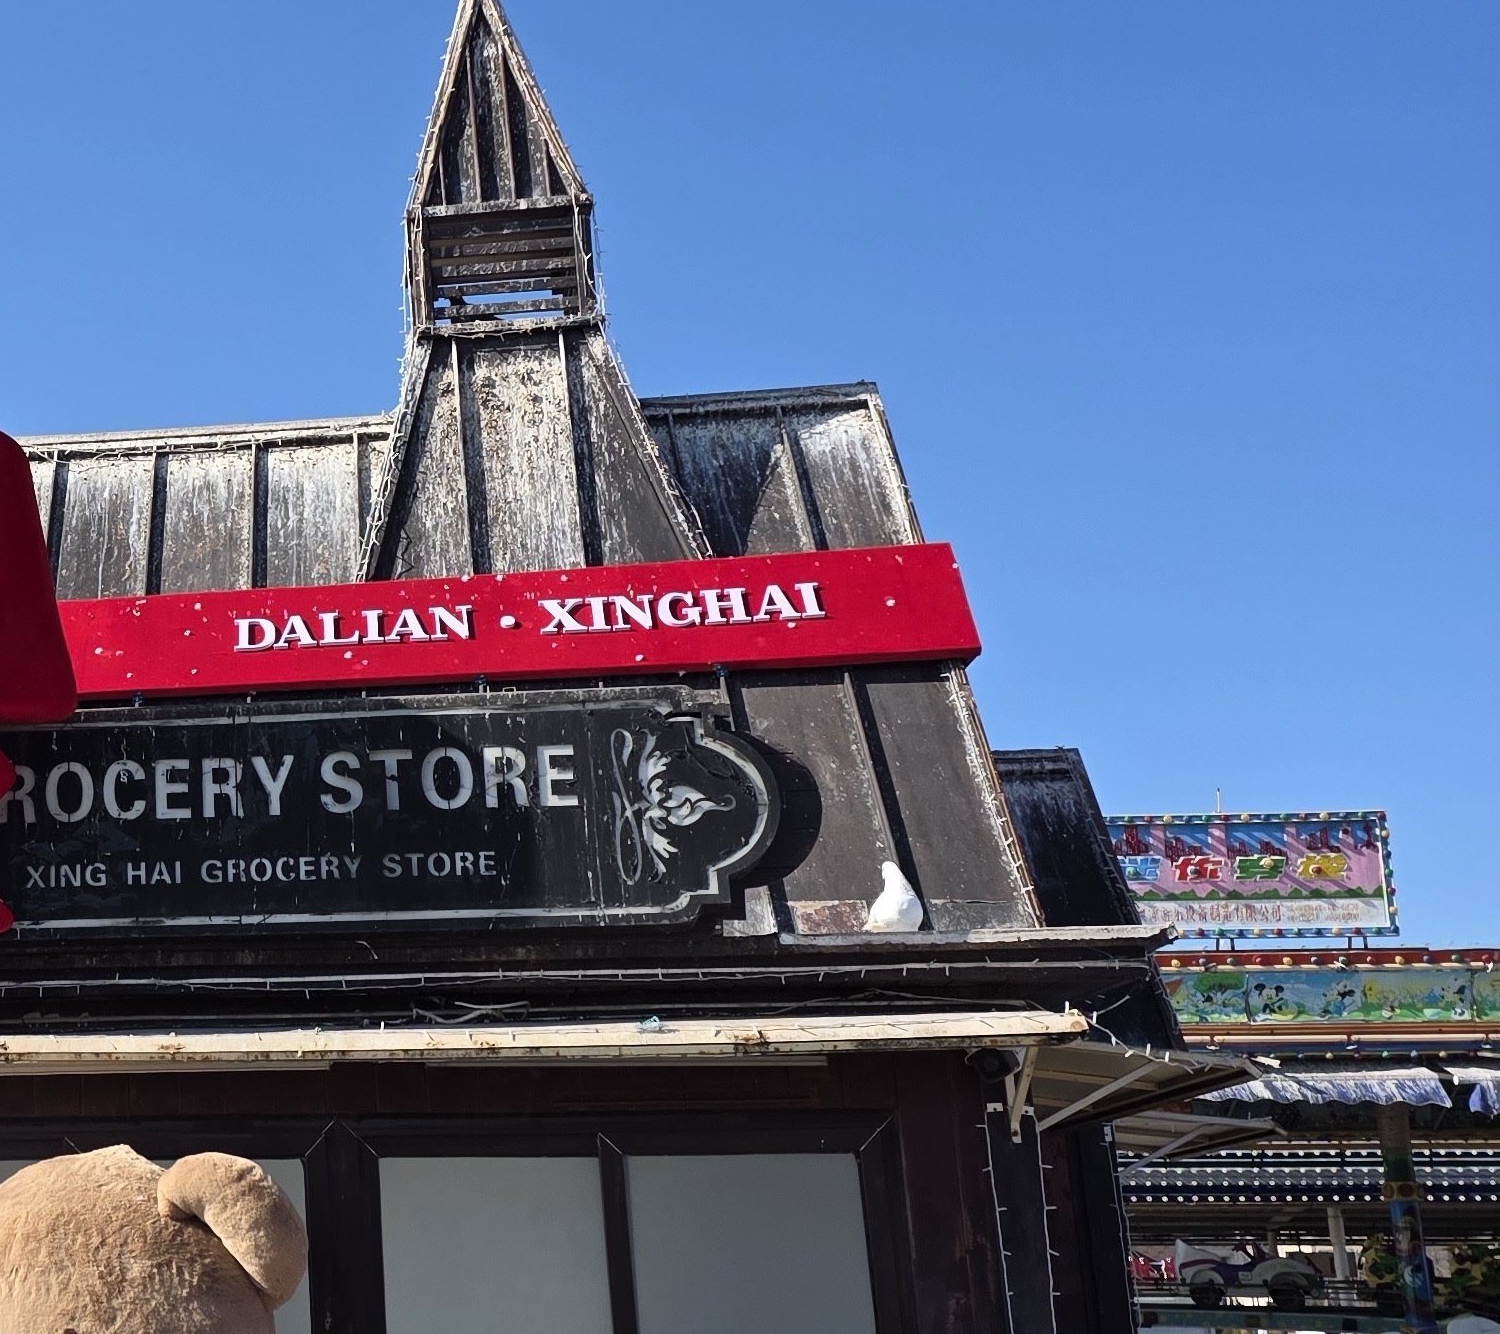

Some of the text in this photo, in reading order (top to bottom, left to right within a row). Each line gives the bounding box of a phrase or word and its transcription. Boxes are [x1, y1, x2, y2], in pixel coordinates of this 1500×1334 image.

[233, 581, 826, 652] DALIAN XINGHAI
[320, 744, 579, 814] STORE
[26, 850, 497, 889] XING HAI GROCERY STORE
